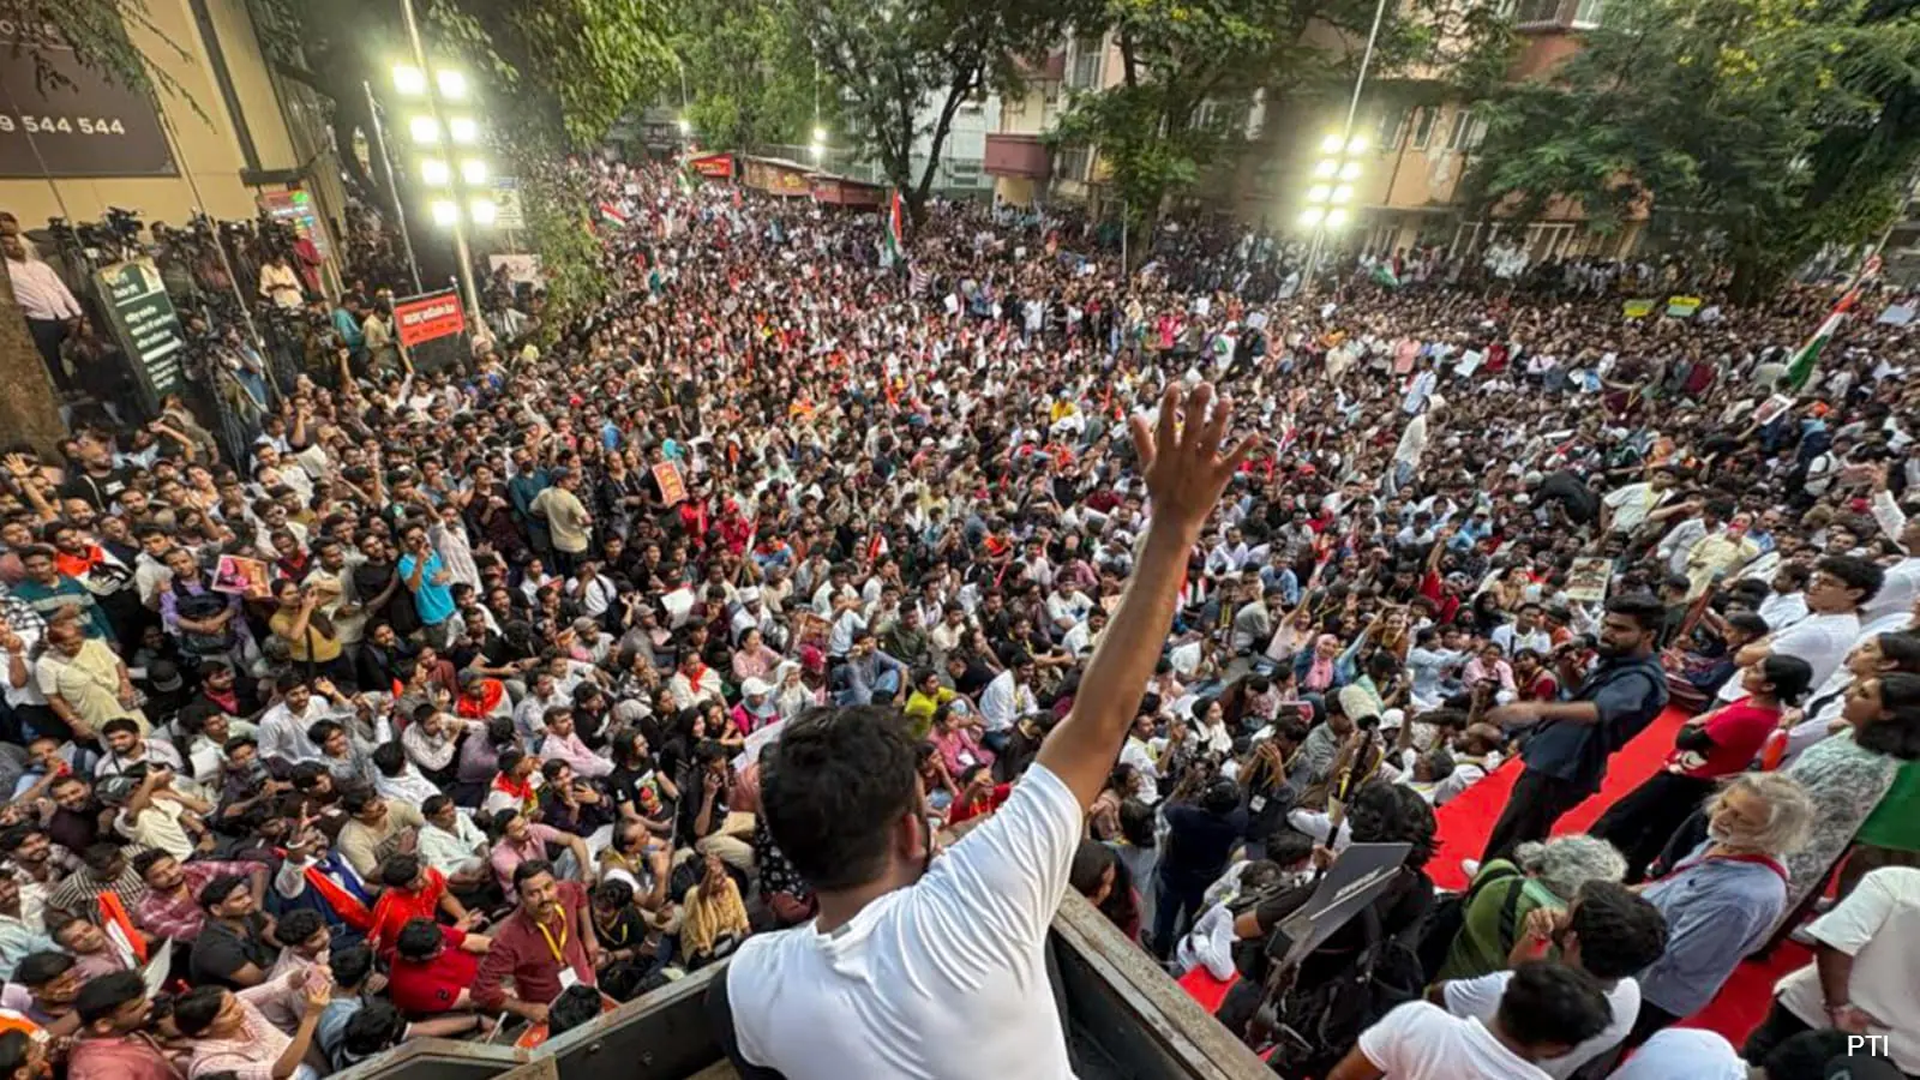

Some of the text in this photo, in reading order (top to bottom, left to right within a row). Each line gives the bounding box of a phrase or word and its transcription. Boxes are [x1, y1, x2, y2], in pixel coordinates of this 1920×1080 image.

[0, 115, 125, 135] 9 544 544
